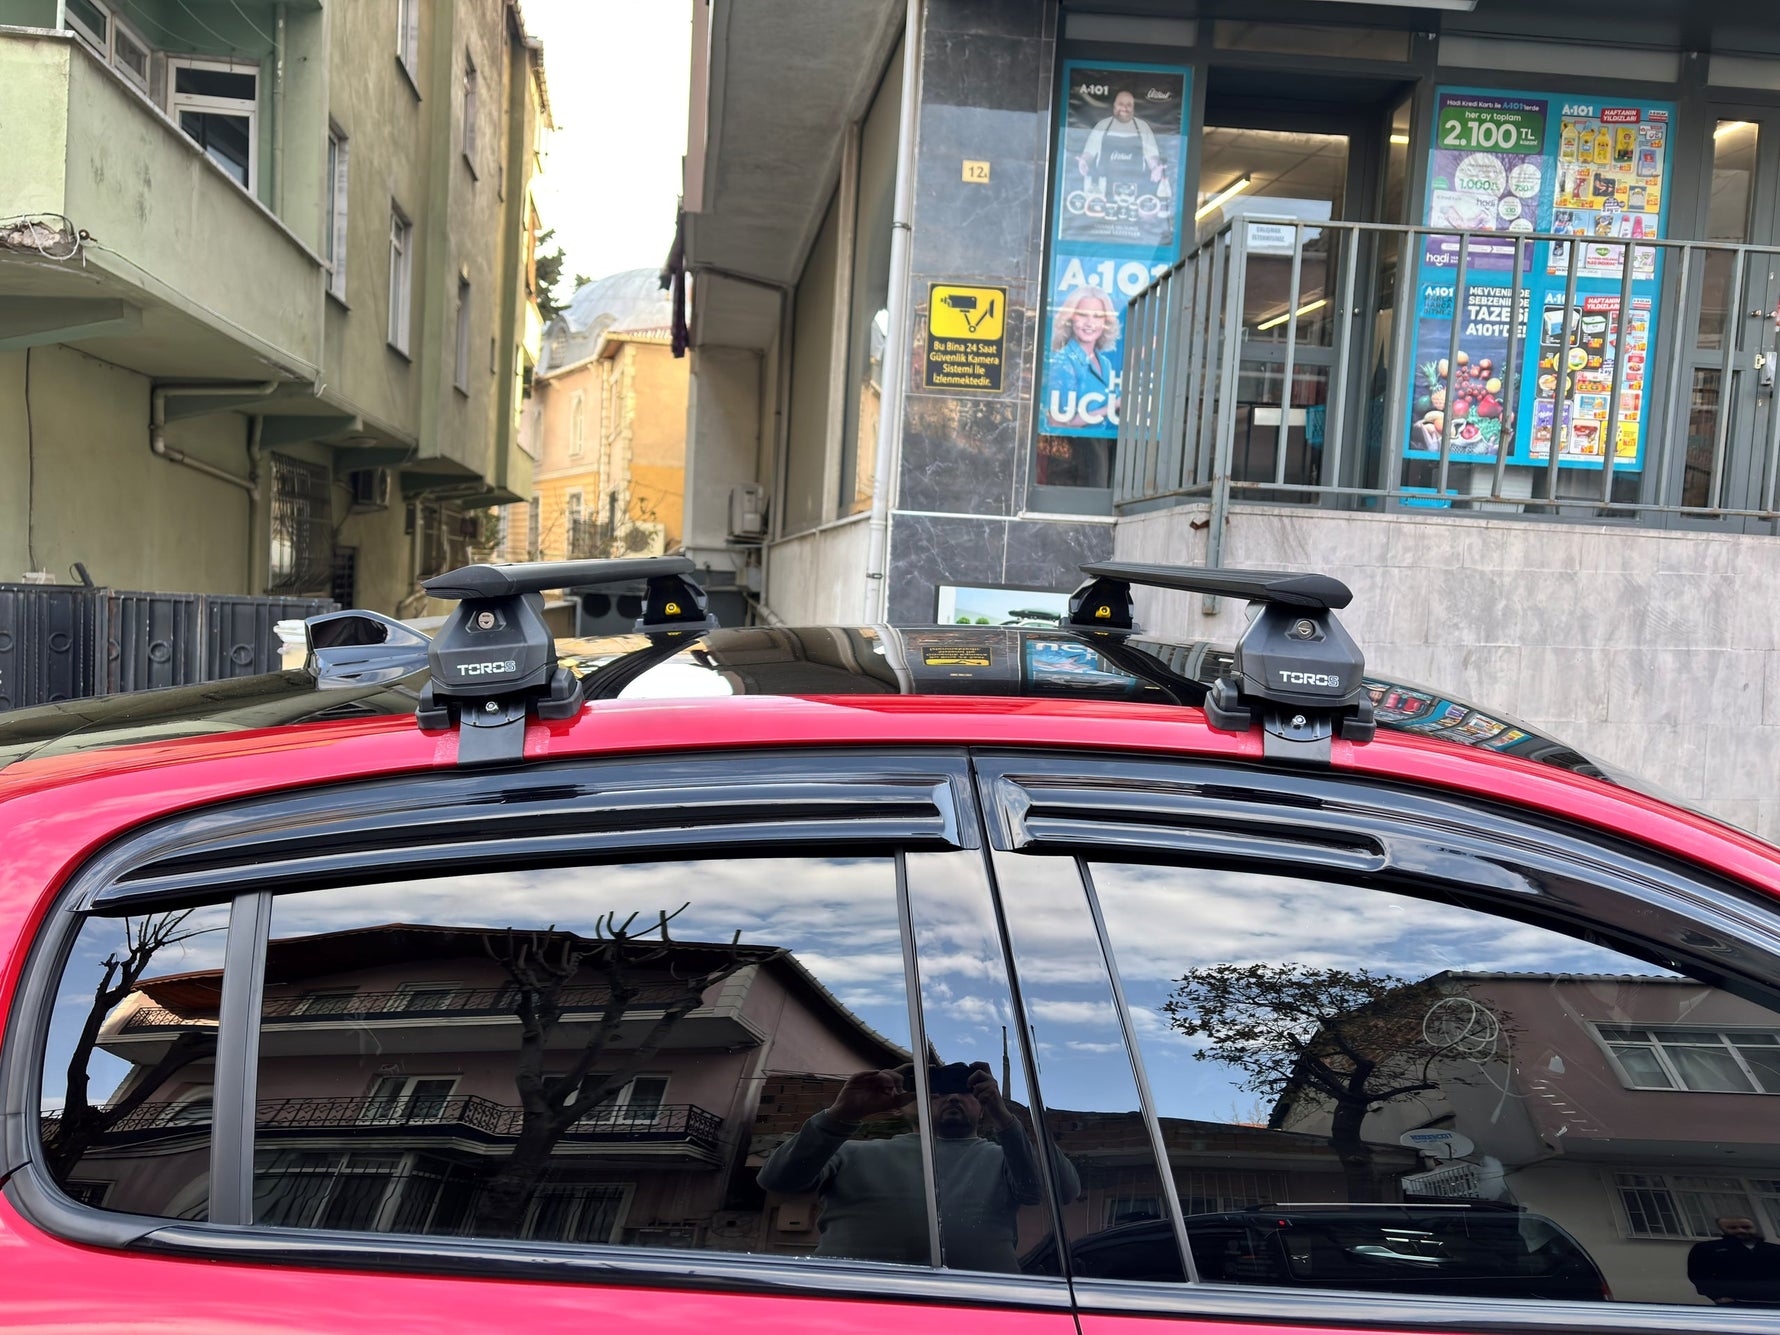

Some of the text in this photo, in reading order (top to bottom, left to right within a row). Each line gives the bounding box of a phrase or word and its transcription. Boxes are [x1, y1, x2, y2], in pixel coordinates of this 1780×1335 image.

[1465, 111, 1521, 122] her ay toplam
[1443, 120, 1535, 149] 2.100 TL
[1426, 252, 1449, 263] hadi
[933, 341, 997, 354] Bu Bina 24 Saat
[929, 351, 1000, 365] Güvenlik Kamera
[942, 363, 973, 374] Sistemi
[457, 660, 516, 676] TOROS
[1279, 670, 1339, 688] TOROS
